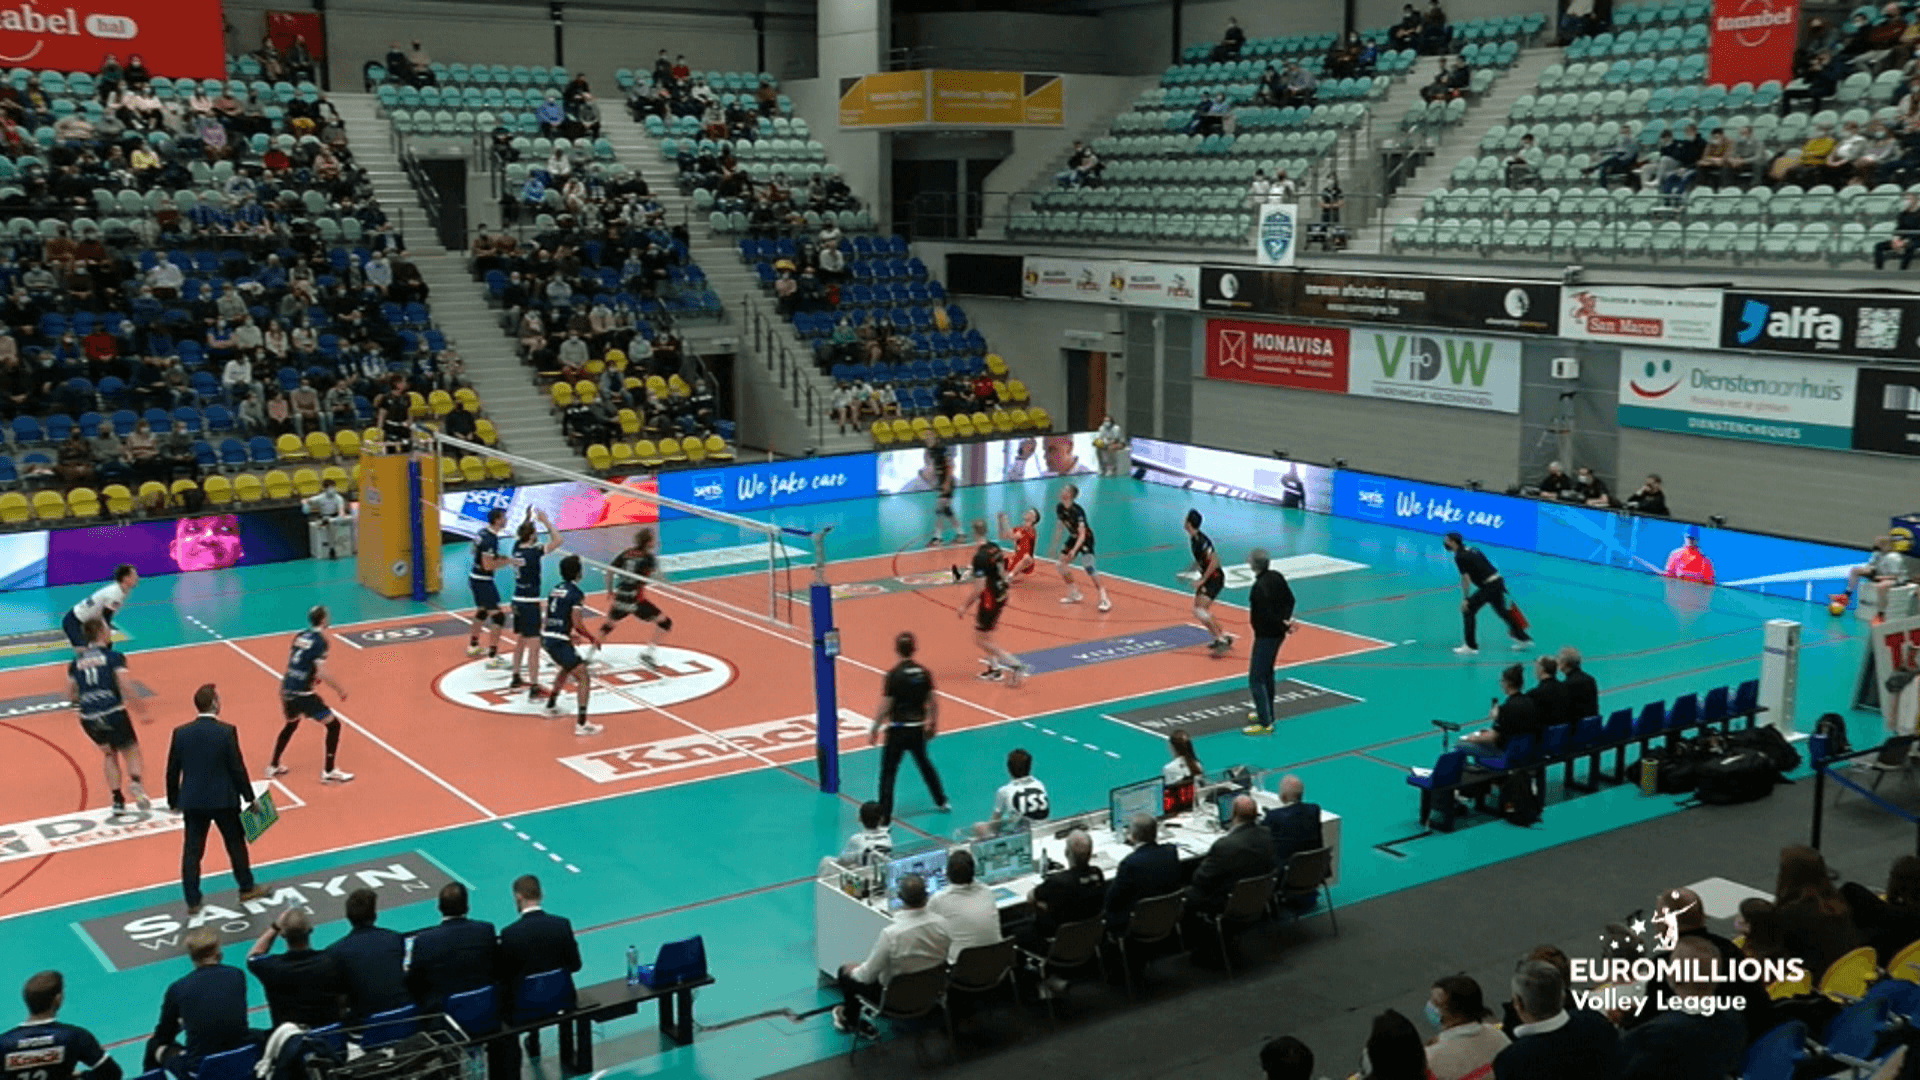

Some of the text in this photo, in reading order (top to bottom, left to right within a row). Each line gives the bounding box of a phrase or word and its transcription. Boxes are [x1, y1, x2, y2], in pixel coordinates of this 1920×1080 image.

[0, 4, 81, 35] abel
[1590, 318, 1616, 331] San
[1618, 320, 1660, 335] Marco
[1253, 332, 1334, 356] MONAVISA
[1374, 333, 1494, 387] VDW
[738, 473, 767, 501] We
[770, 471, 808, 497] take
[812, 473, 848, 489] care
[1396, 491, 1424, 517] We
[1427, 498, 1464, 523] take
[1467, 510, 1505, 529] care
[124, 863, 418, 941] SAMYN
